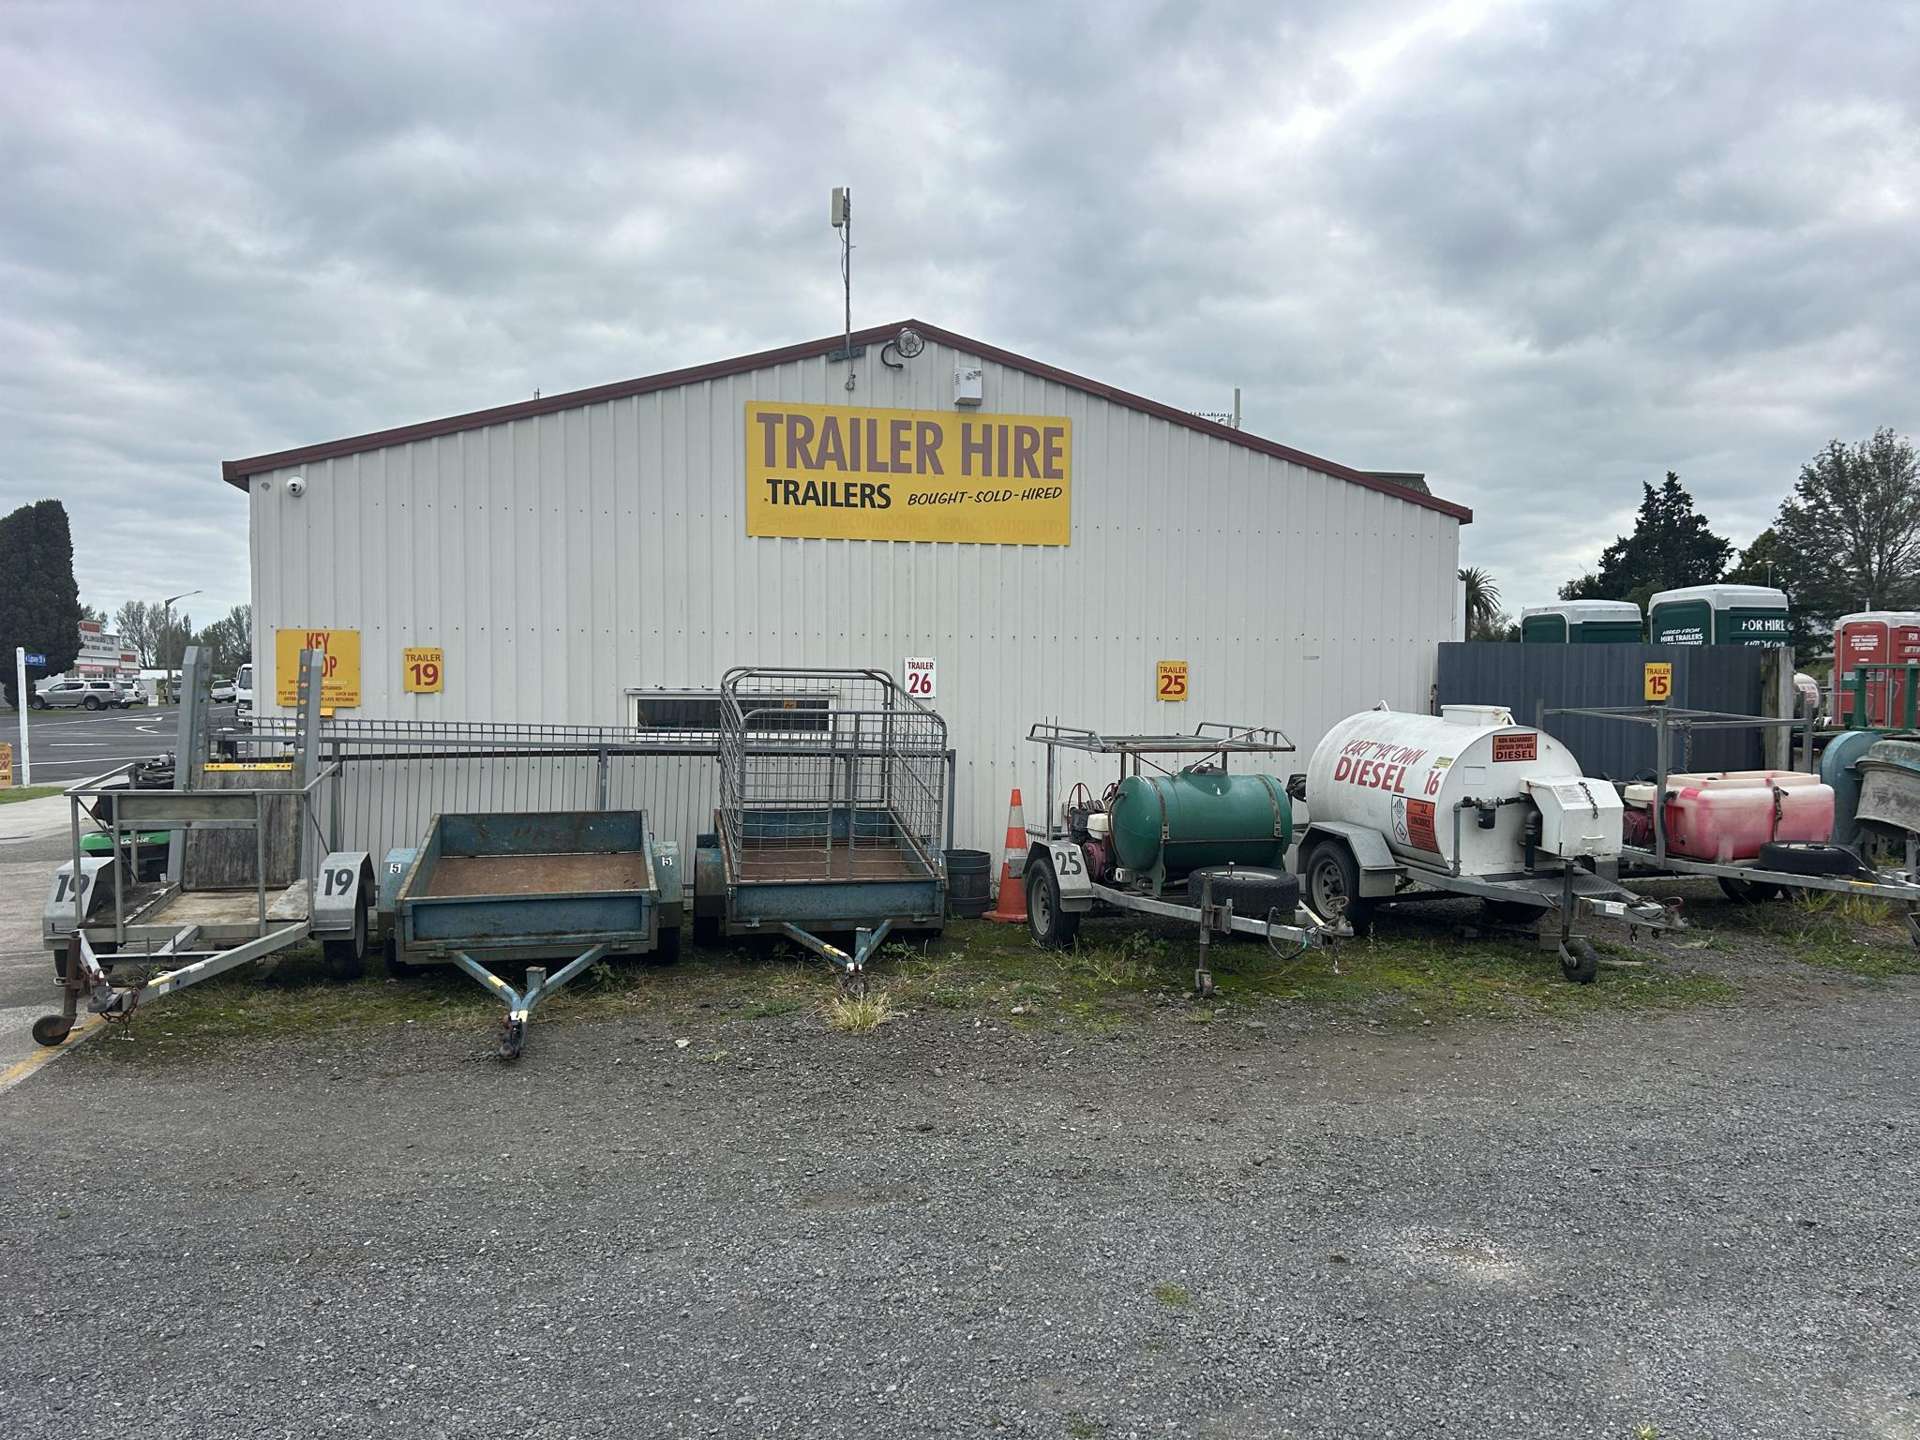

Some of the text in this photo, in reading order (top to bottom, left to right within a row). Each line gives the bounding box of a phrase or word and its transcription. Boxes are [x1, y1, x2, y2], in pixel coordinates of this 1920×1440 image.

[756, 412, 1065, 480] TRAILER HIRE
[766, 478, 892, 509] TRAILERS
[1742, 619, 1763, 631] FOR
[1675, 633, 1703, 641] TRAILERS
[405, 653, 441, 662] TRAILER
[907, 661, 934, 670] TRAILER
[409, 663, 439, 687] 19
[1160, 666, 1188, 674] TRAILER
[908, 672, 932, 694] 26
[1160, 674, 1186, 695] 25
[1649, 676, 1668, 695] 15
[1340, 739, 1378, 758] KART
[1390, 747, 1429, 766] OWN
[1495, 750, 1534, 760] DIESEL
[1334, 756, 1408, 794] DIESEL
[1424, 770, 1443, 796] 16
[392, 863, 400, 874] 5
[1055, 851, 1083, 876] 25
[324, 868, 354, 896] 19
